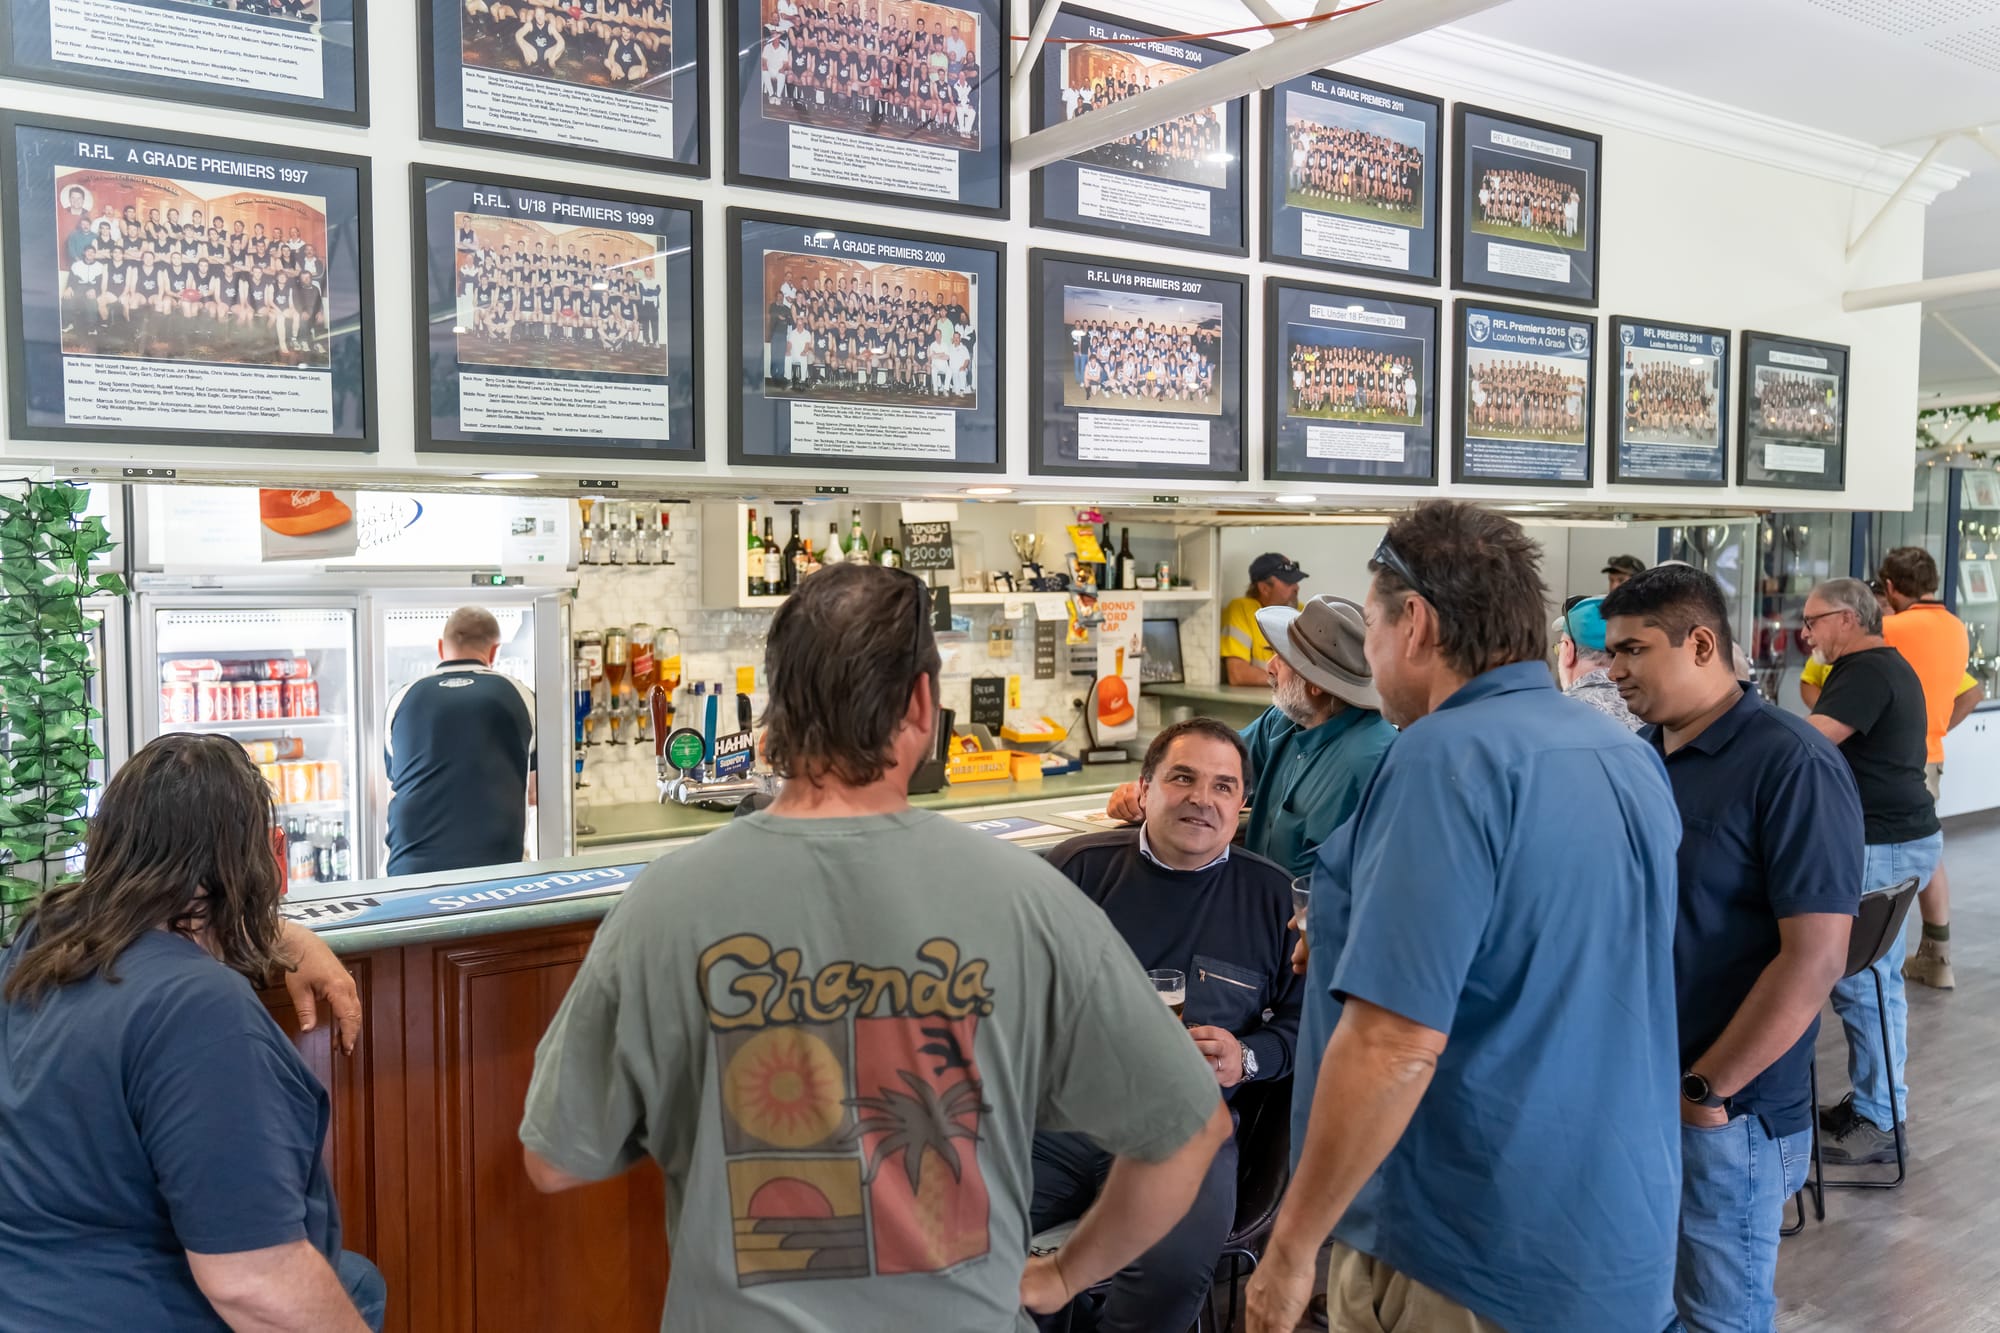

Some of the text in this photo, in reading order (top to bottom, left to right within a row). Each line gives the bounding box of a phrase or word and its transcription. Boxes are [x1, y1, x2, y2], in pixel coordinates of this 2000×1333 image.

[1148, 42, 1184, 58] PREMIERS
[1186, 51, 1202, 62] 2004
[1330, 85, 1336, 96] A
[1337, 88, 1360, 101] GRADE
[1360, 93, 1391, 109] PREMIERS
[1392, 101, 1404, 112] 2011
[78, 142, 308, 184] R.F.L A GRADE PREMIERS 1997
[473, 192, 655, 225] R.F.L. U/18 PREMIERS 1999
[833, 239, 840, 250] A
[843, 240, 875, 255] GRADE
[878, 245, 923, 261] PREMIERS
[925, 251, 946, 264] 2000
[1112, 273, 1132, 285] U/18
[1134, 276, 1180, 291] PREMIERS
[1182, 282, 1202, 293] 2007
[1327, 309, 1347, 318] Under
[1493, 319, 1566, 336] RFL Premiers 2015
[1644, 328, 1656, 338] RFL
[1657, 329, 1688, 342] PREMIERS
[1493, 332, 1516, 342] Loxton
[1517, 335, 1536, 345] North
[1545, 338, 1565, 348] Grade
[1101, 601, 1136, 610] BONUS
[716, 732, 753, 755] HAHN
[720, 755, 746, 768] SuperDry
[280, 868, 626, 920] AHN SuperDry
